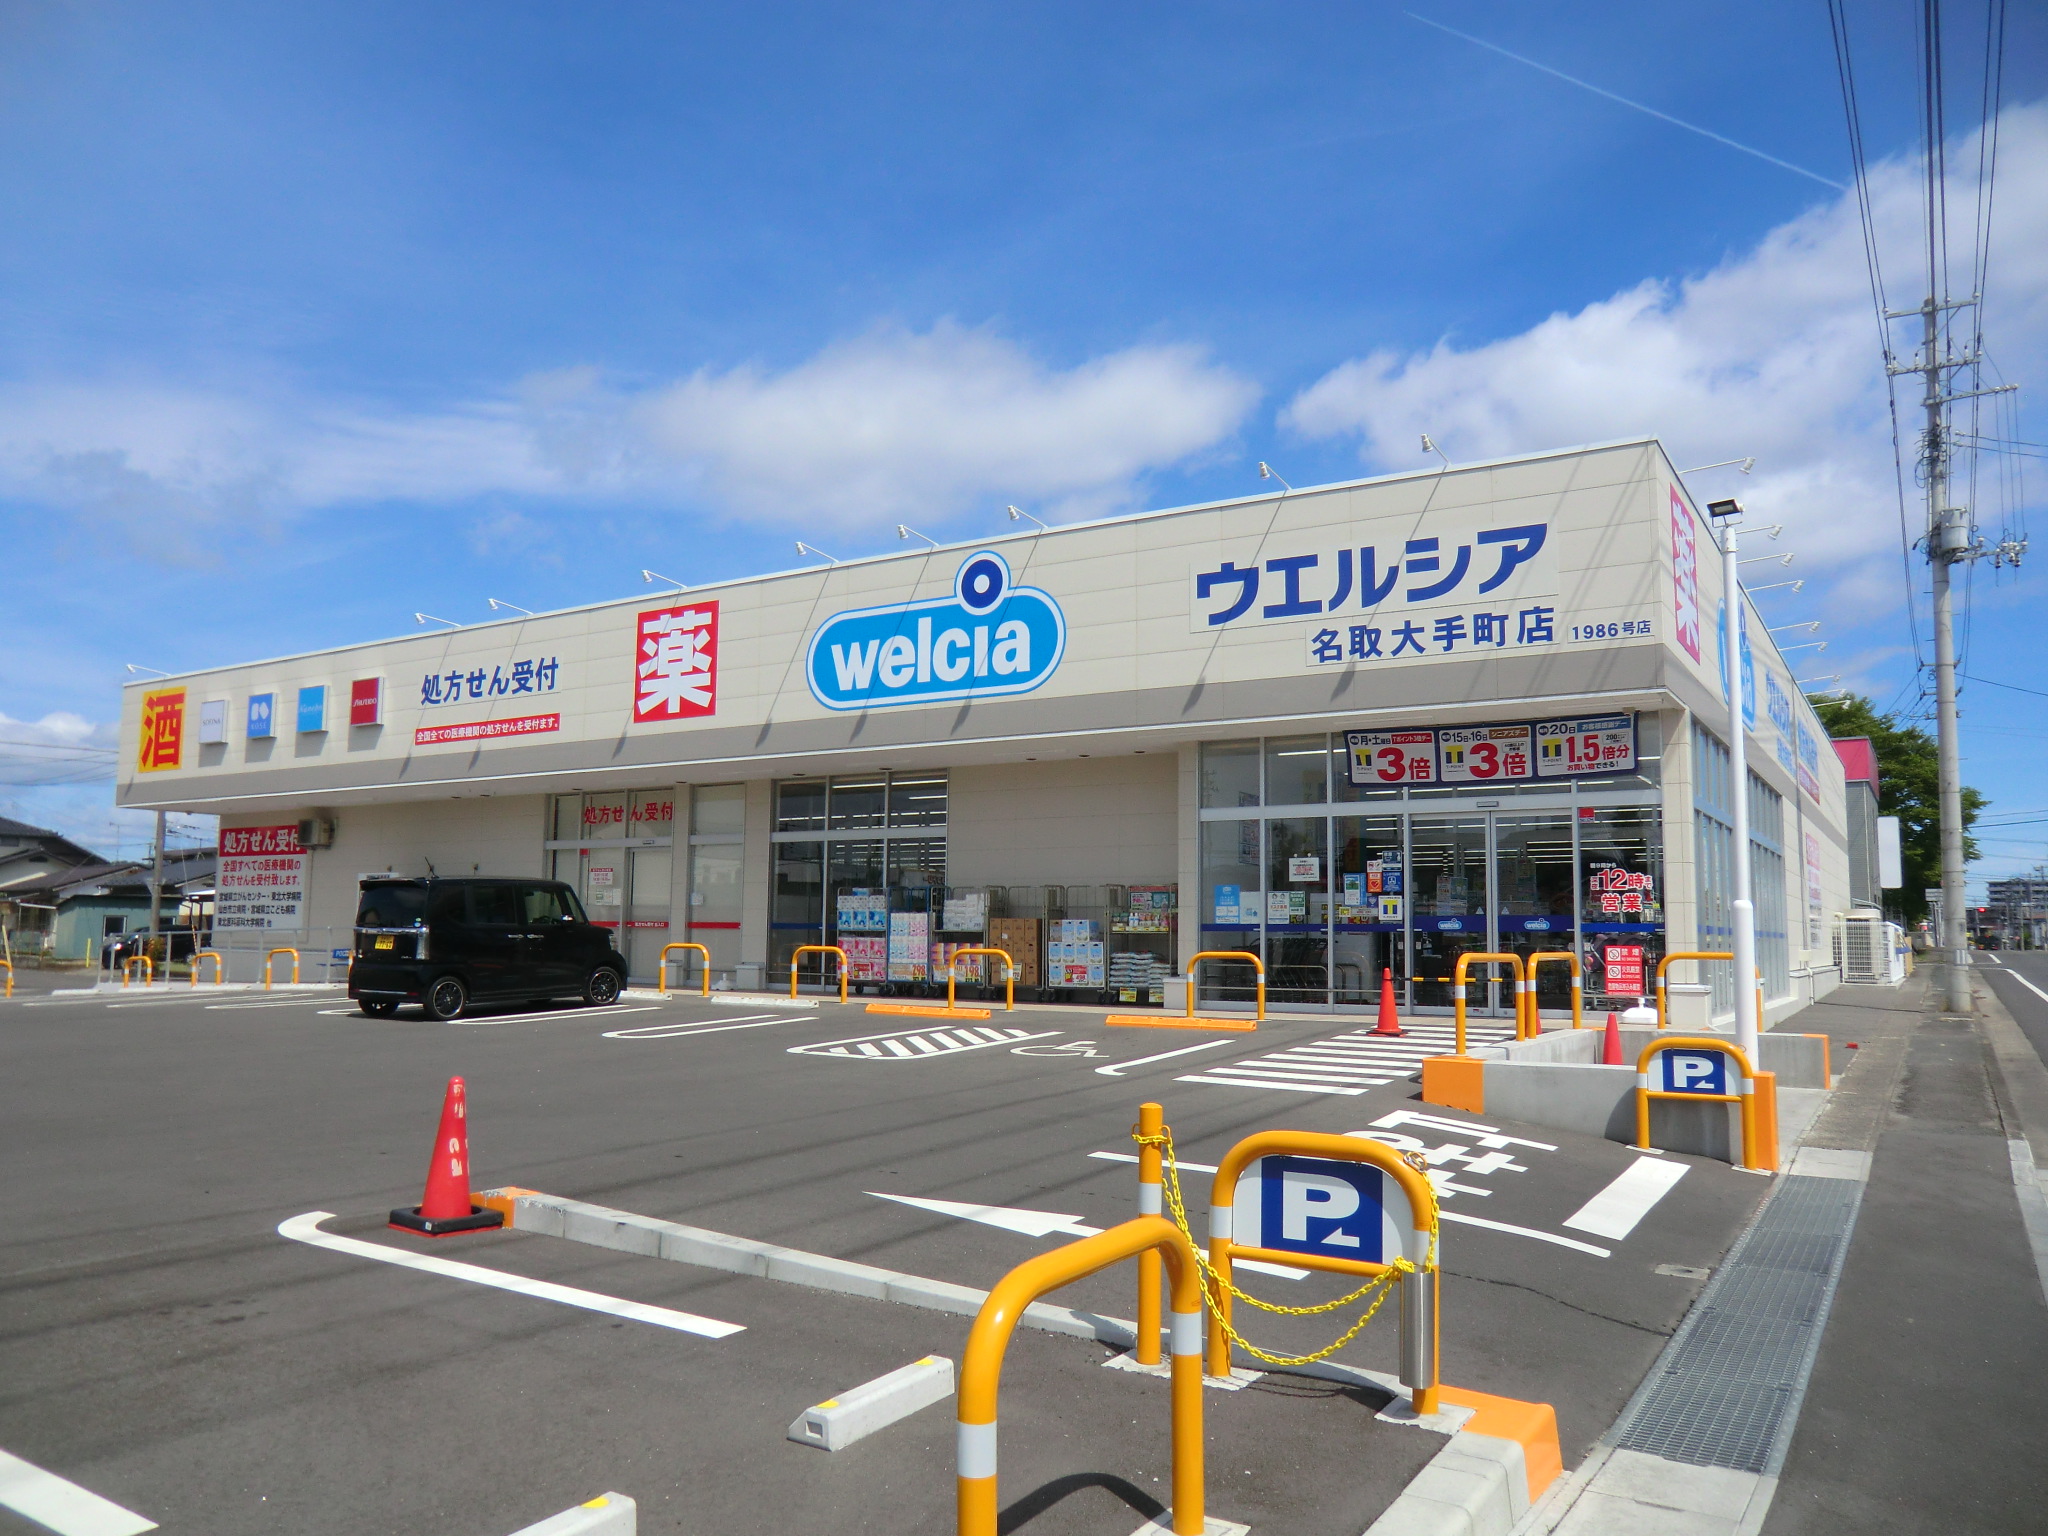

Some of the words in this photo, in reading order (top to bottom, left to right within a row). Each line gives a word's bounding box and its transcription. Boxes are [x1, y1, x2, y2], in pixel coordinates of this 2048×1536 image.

[1196, 523, 1548, 627] ウエルシア
[830, 615, 1032, 692] welcia
[1311, 606, 1555, 664] 名取大手町店
[1571, 619, 1652, 641] 1986号店
[420, 656, 559, 706] 処方せん受付
[637, 610, 714, 715] 薬
[141, 692, 187, 768] 酒
[584, 801, 673, 825] 処方せん受付
[221, 873, 300, 887] 処方せんを受付致します。
[222, 858, 301, 873] 全国すべての医療機関の
[1601, 892, 1643, 913] 営業
[1673, 1055, 1714, 1089] P
[1282, 1170, 1361, 1242] P
